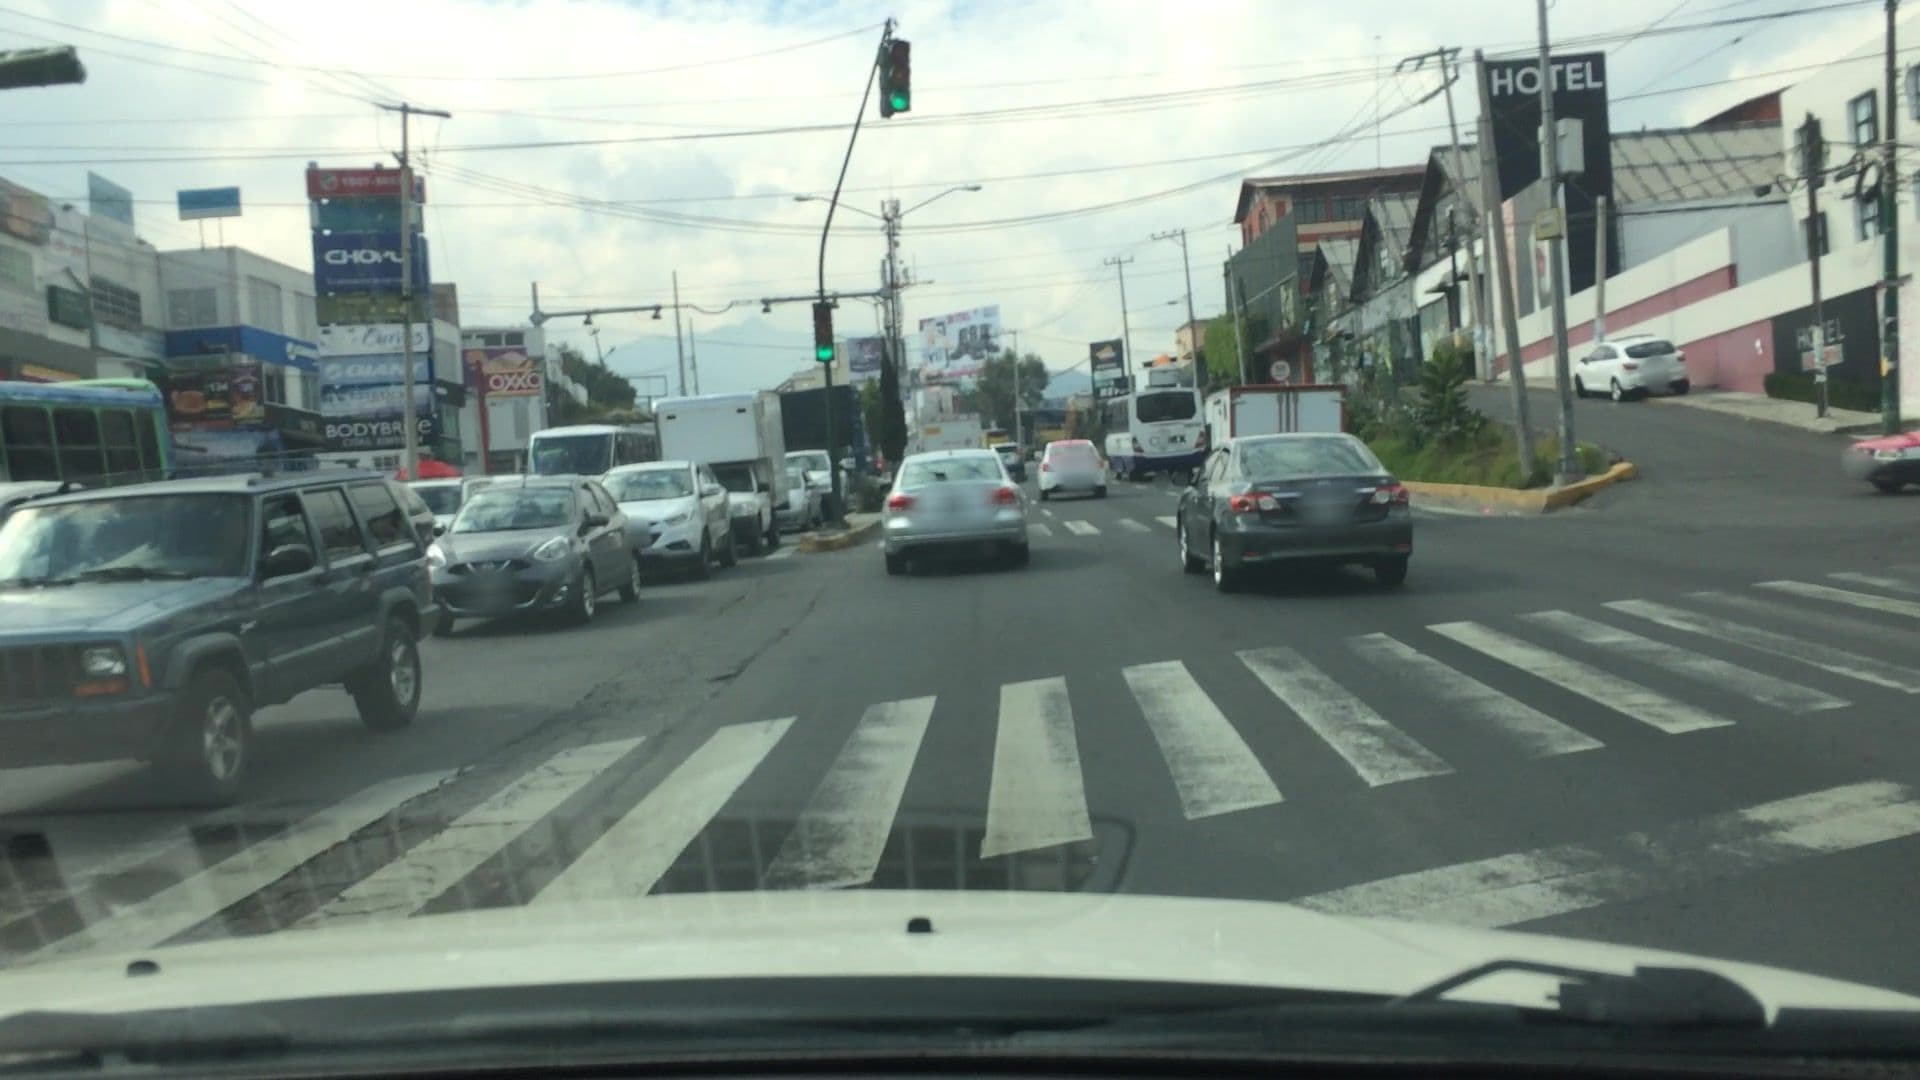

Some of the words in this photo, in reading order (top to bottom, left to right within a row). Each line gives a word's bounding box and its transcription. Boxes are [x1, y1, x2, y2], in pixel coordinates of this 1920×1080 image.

[1490, 61, 1604, 97] HOTEL
[1796, 318, 1846, 350] HOEL
[489, 373, 543, 392] OXXO
